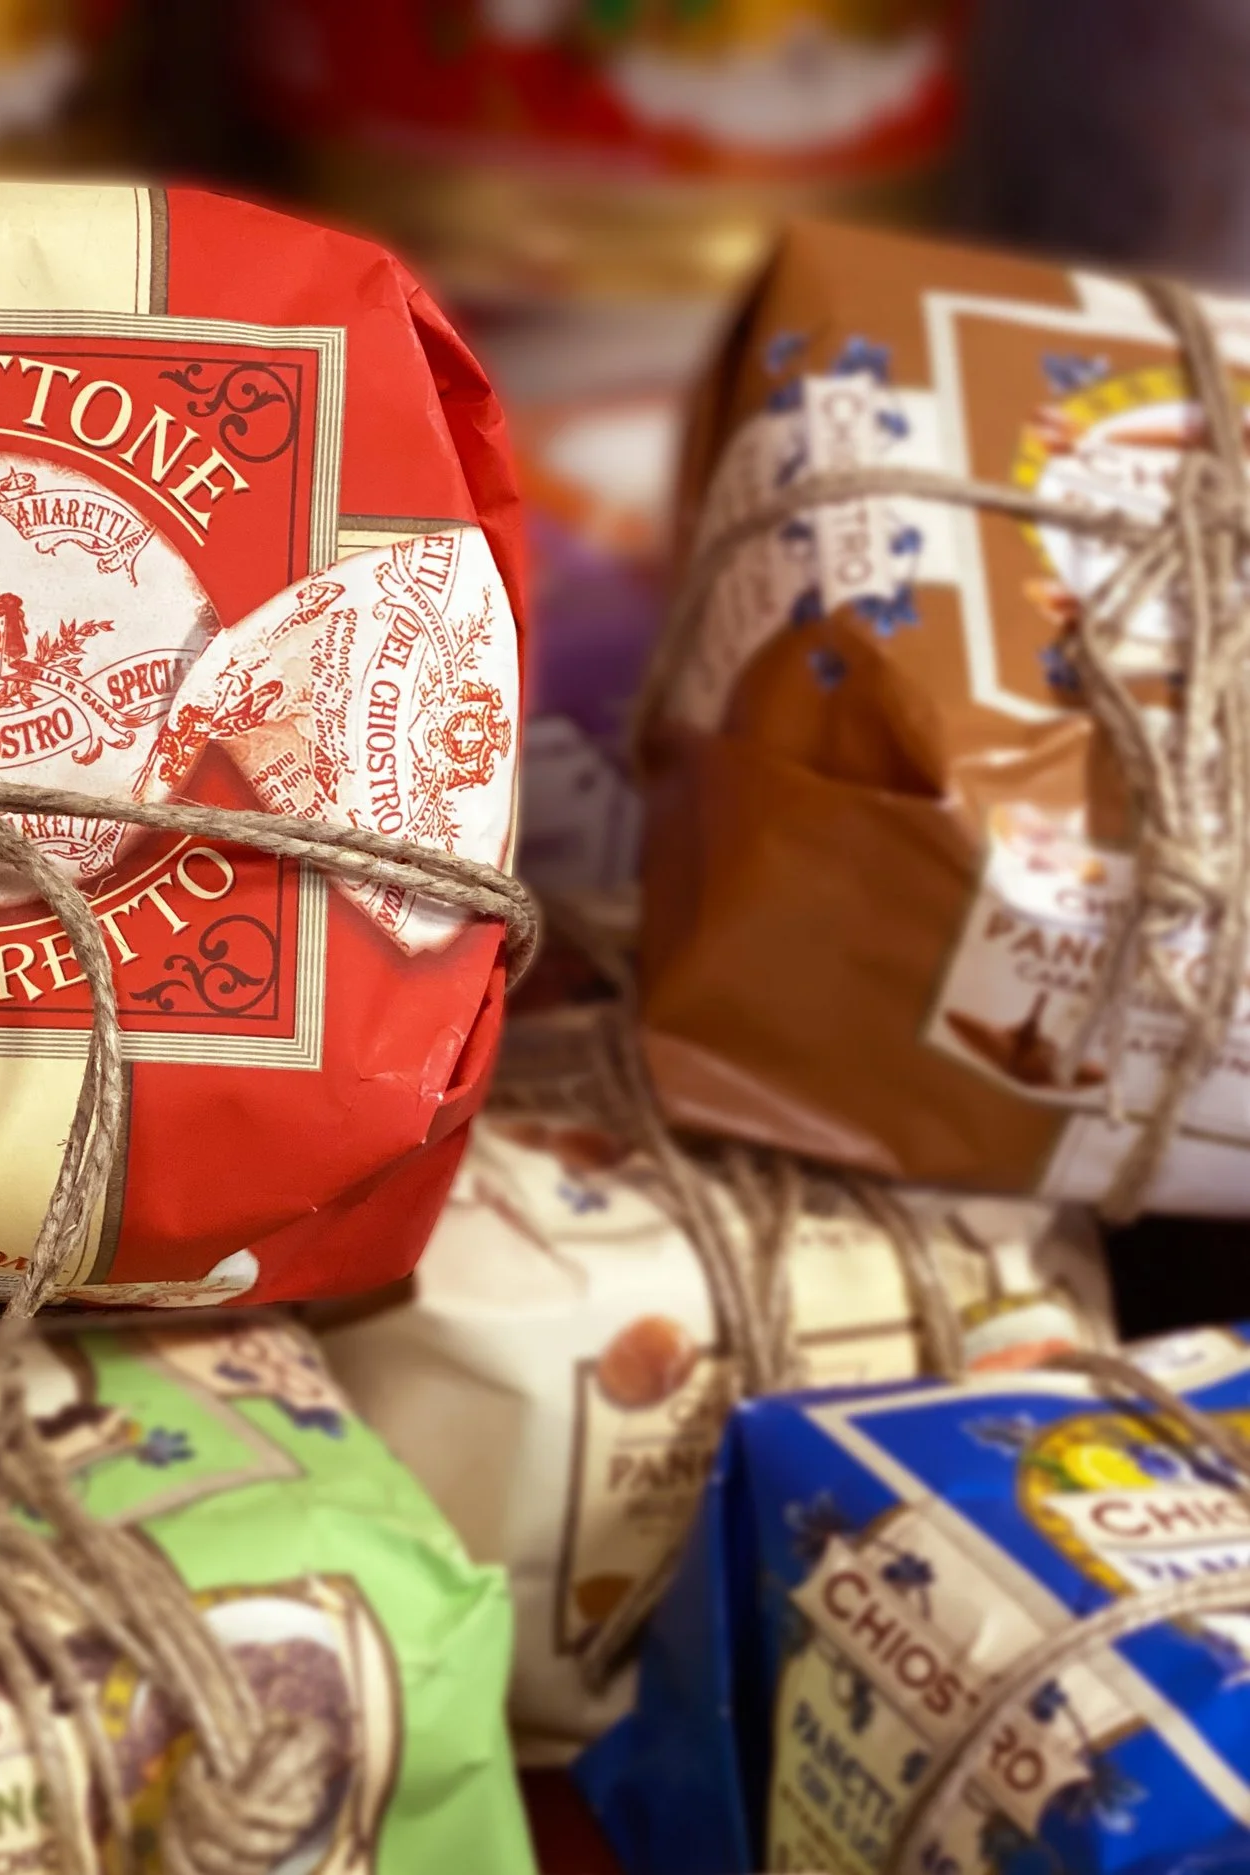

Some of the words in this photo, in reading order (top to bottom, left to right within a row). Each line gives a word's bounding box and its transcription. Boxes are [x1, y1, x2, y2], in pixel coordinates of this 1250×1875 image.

[16, 498, 133, 542] AMARETTI
[376, 613, 421, 670] DEL
[365, 678, 403, 836] CHIOSTRO
[20, 813, 101, 845] ARETTI
[822, 1570, 1046, 1794] CHIOSRO
